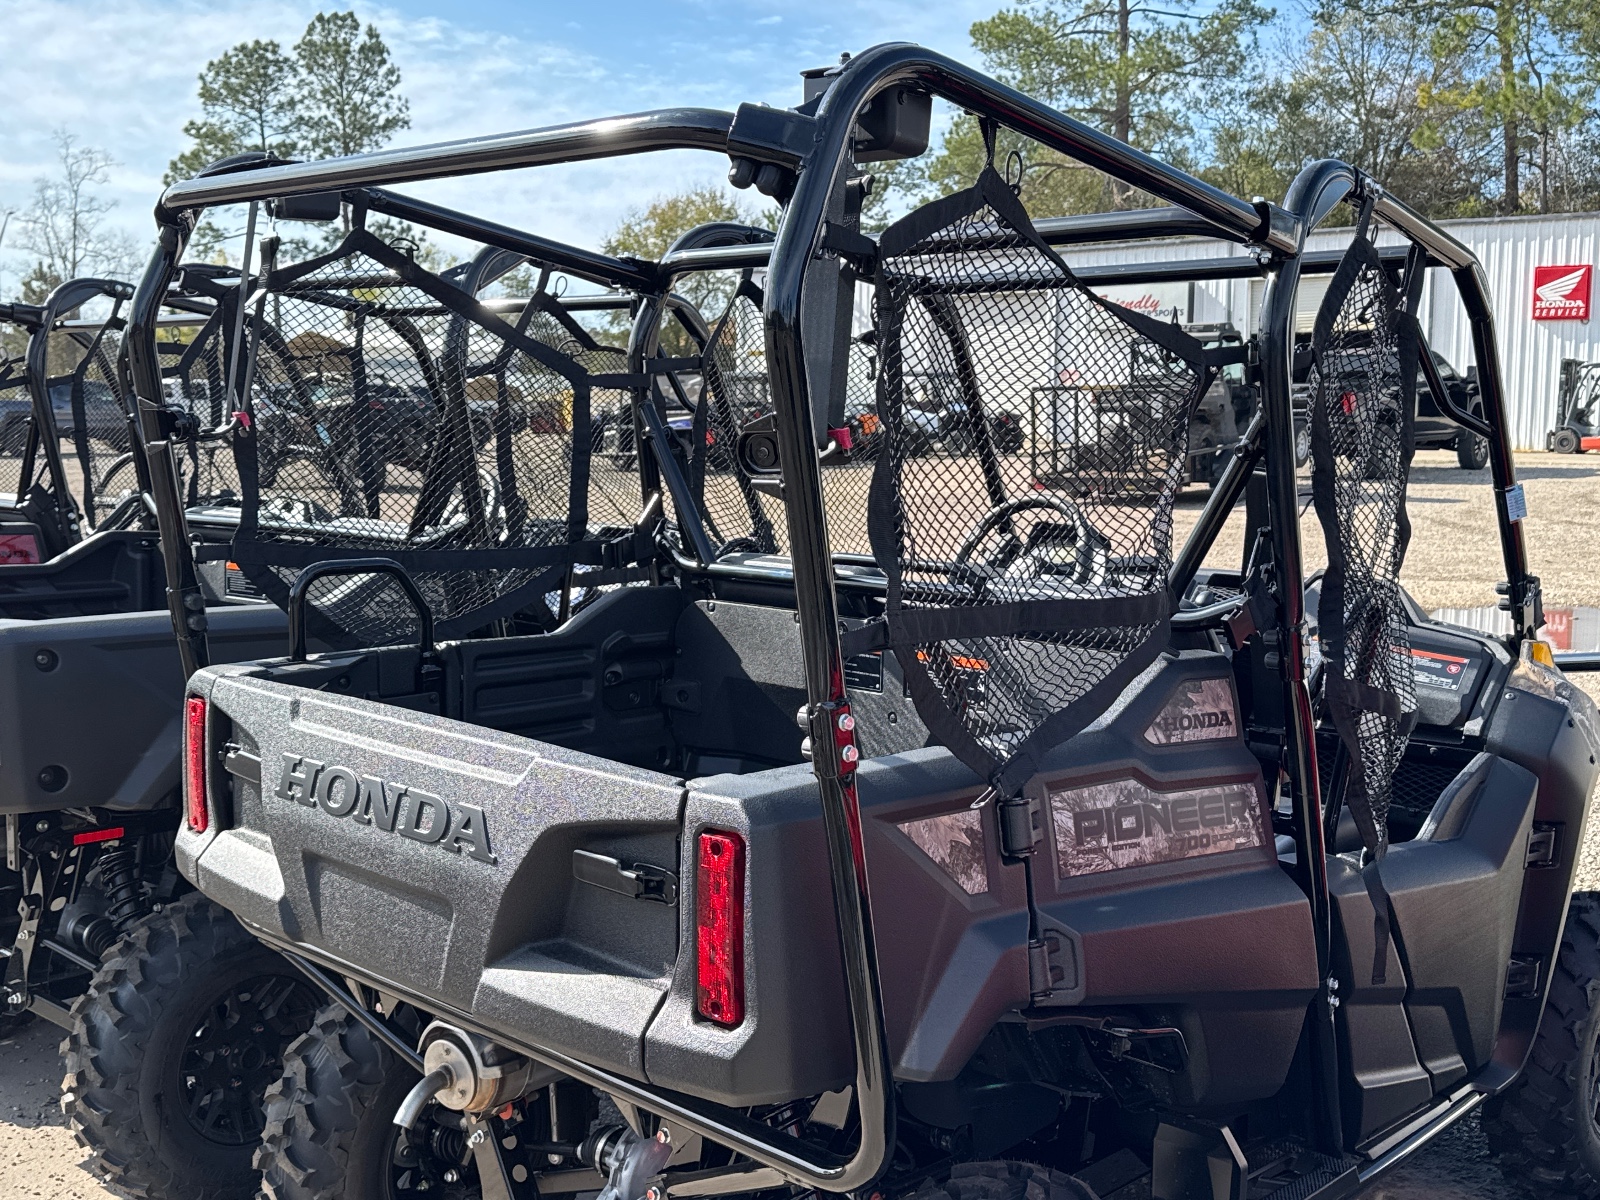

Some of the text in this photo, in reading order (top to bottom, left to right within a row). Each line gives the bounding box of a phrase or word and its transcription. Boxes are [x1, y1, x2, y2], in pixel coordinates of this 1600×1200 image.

[1535, 300, 1586, 308] HONDA
[1535, 308, 1586, 317] SERVICE
[1162, 711, 1232, 731] HONDA
[274, 752, 498, 864] HONDA
[1073, 791, 1248, 845] PIONEER
[1112, 842, 1141, 851] EDITION
[1176, 833, 1211, 851] 700
